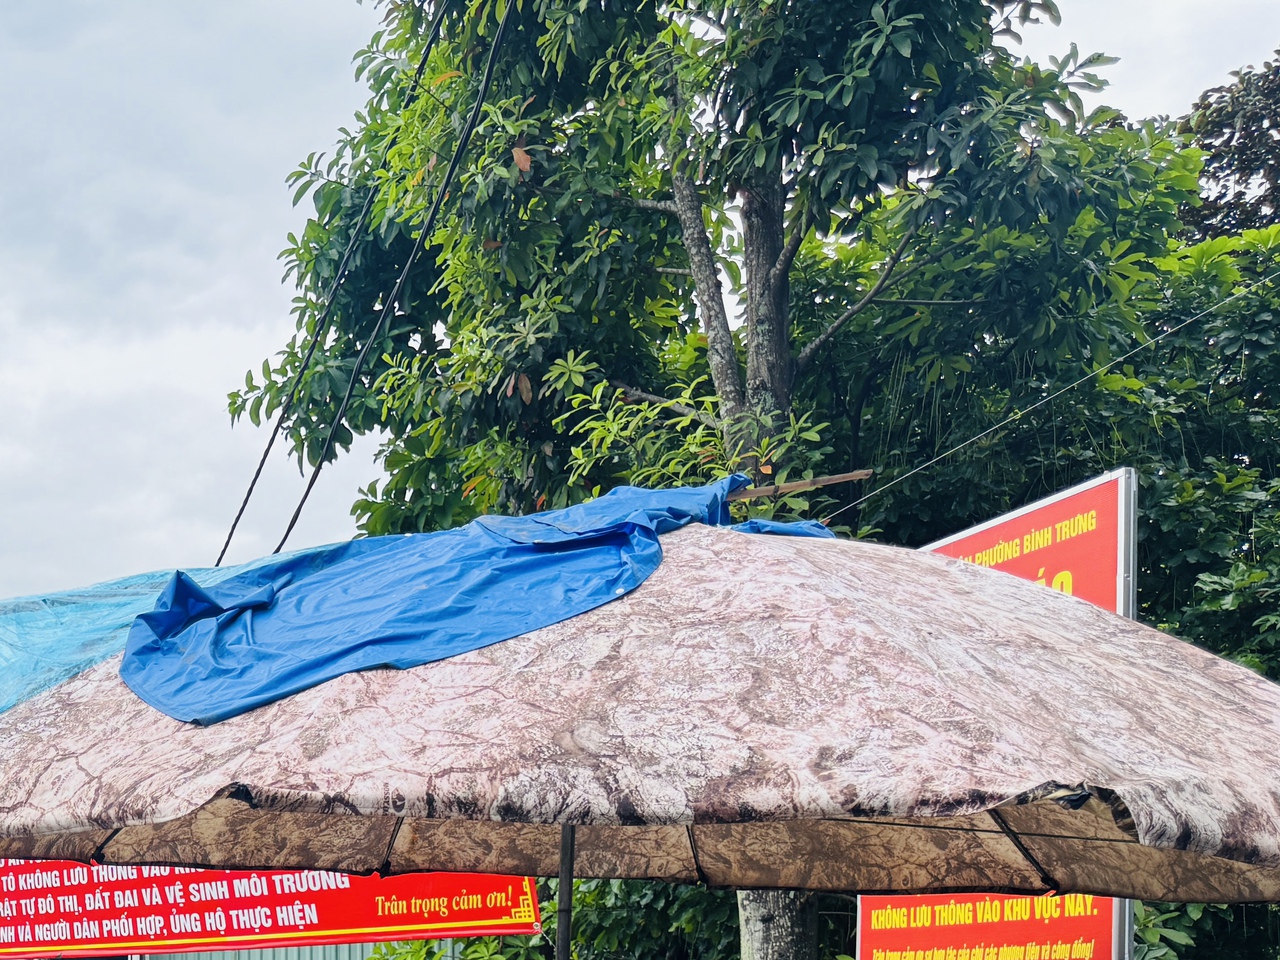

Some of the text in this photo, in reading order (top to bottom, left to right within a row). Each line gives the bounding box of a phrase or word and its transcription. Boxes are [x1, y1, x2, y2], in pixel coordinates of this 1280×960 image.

[1023, 529, 1052, 554] BÌNH
[1055, 510, 1096, 542] TRƯNG
[1, 872, 16, 892] TÔ
[18, 869, 61, 890] KHÔNG
[63, 866, 88, 886] LƯU
[20, 897, 35, 918] TỰ
[38, 894, 55, 914] ĐÔ
[57, 895, 82, 915] THỊ,
[85, 886, 111, 910] ĐẤT
[114, 889, 139, 908] ĐAI
[142, 884, 162, 906] VÀ
[165, 881, 185, 907] VỆ
[189, 881, 229, 902] SINH
[233, 873, 268, 898] MÔI
[375, 885, 512, 918] Trân trọng cảm ơn!
[871, 904, 908, 929] KHÔNG
[910, 904, 932, 928] LƯU
[934, 899, 973, 926] THÔNG
[976, 896, 1000, 923] VÀO
[1004, 897, 1030, 921] KHU
[18, 921, 32, 942] VÀ
[35, 918, 71, 941] NGƯỜI
[73, 917, 100, 939] DÂN
[102, 912, 134, 938] PHỐI
[136, 914, 168, 939] HỢP,
[169, 908, 201, 934] ỦNG
[204, 907, 226, 934] HỘ
[229, 906, 272, 932] THỰC
[276, 900, 318, 929] HIỆN
[1041, 941, 1051, 960] và
